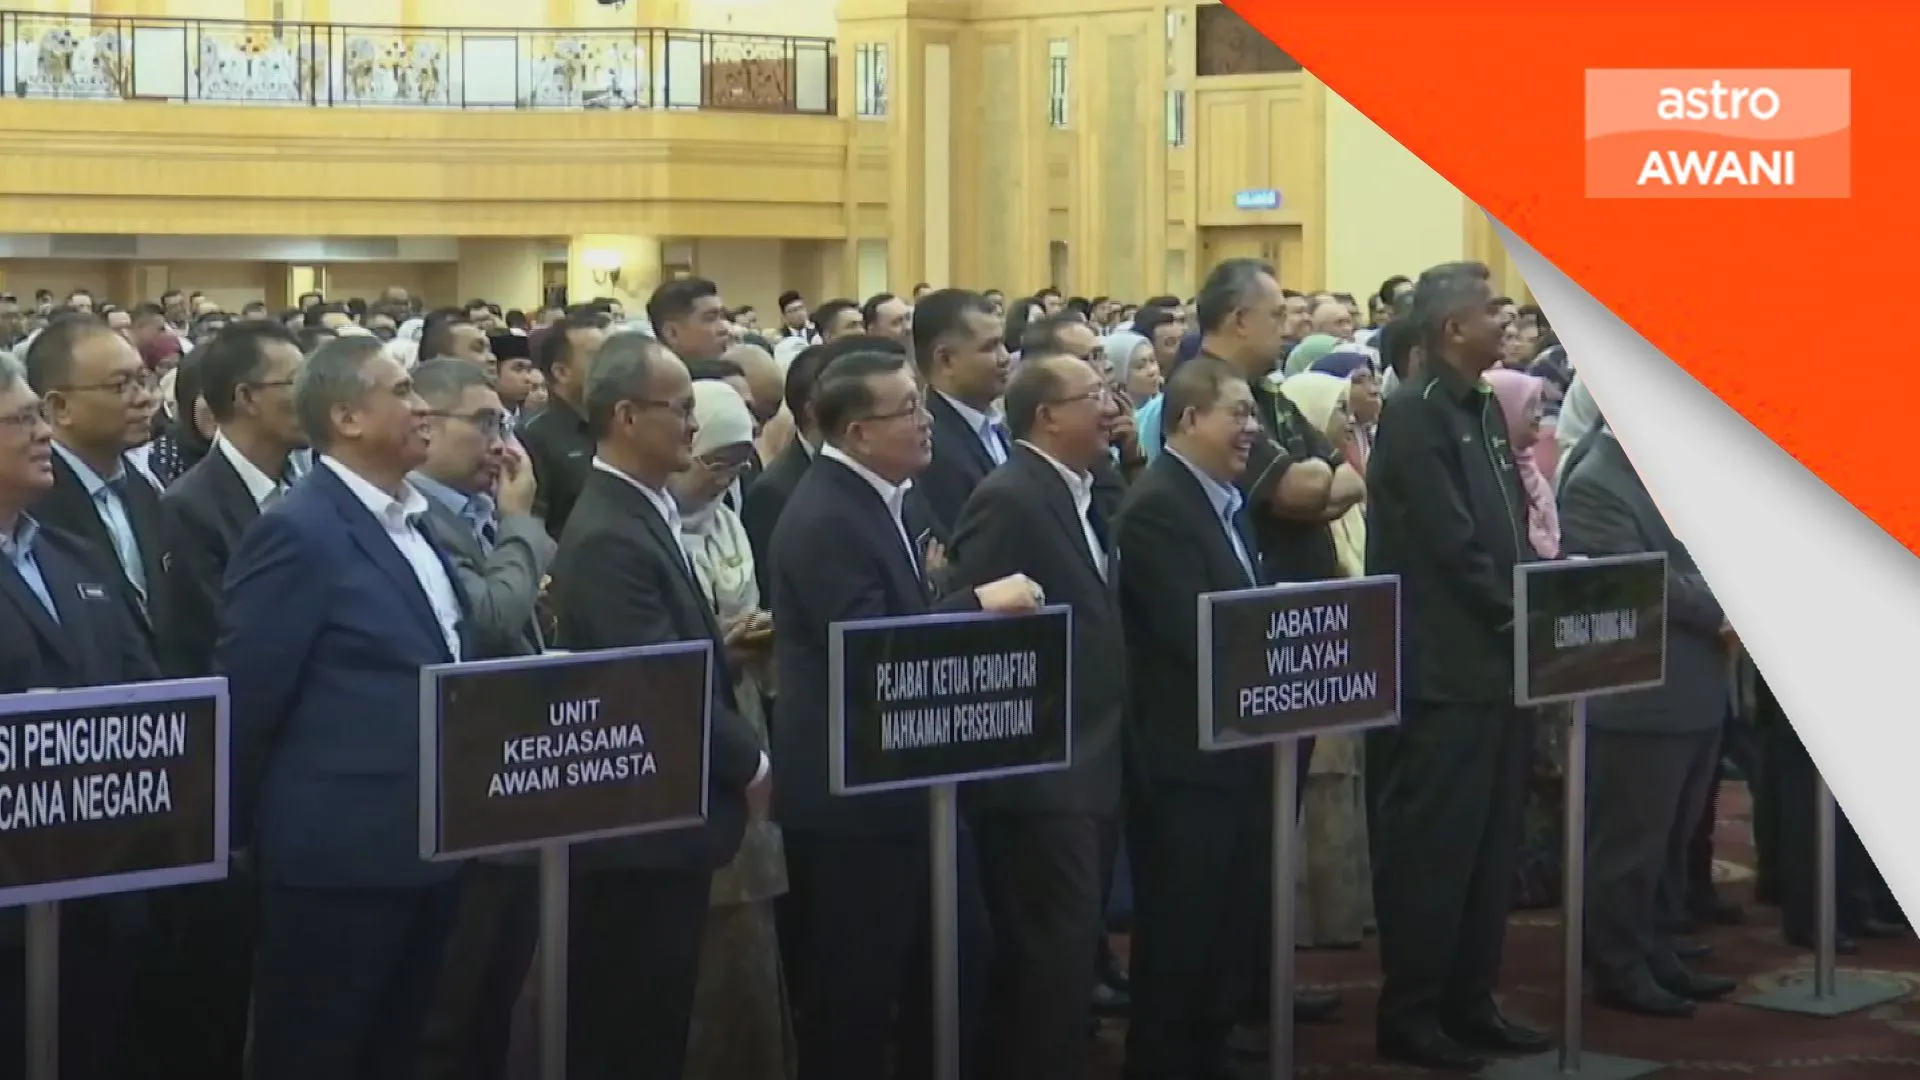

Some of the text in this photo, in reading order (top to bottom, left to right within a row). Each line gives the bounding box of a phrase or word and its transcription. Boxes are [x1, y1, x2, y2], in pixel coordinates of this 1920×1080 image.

[1266, 602, 1348, 640] JABATAN
[877, 650, 1037, 701] PEJABAT KETUA PENDAFTAR
[1267, 639, 1348, 676] WILAYAH
[550, 698, 600, 726] UNIT
[1239, 670, 1377, 718] PERSEKUTUAN
[24, 711, 186, 769] PENGURUSAN
[504, 724, 645, 764] KERJASAMA
[881, 698, 1033, 751] MAHKAMAH PERSEKUTUAN
[488, 752, 657, 797] AWAM SWASTA
[0, 768, 172, 830] CANA NEGARA
